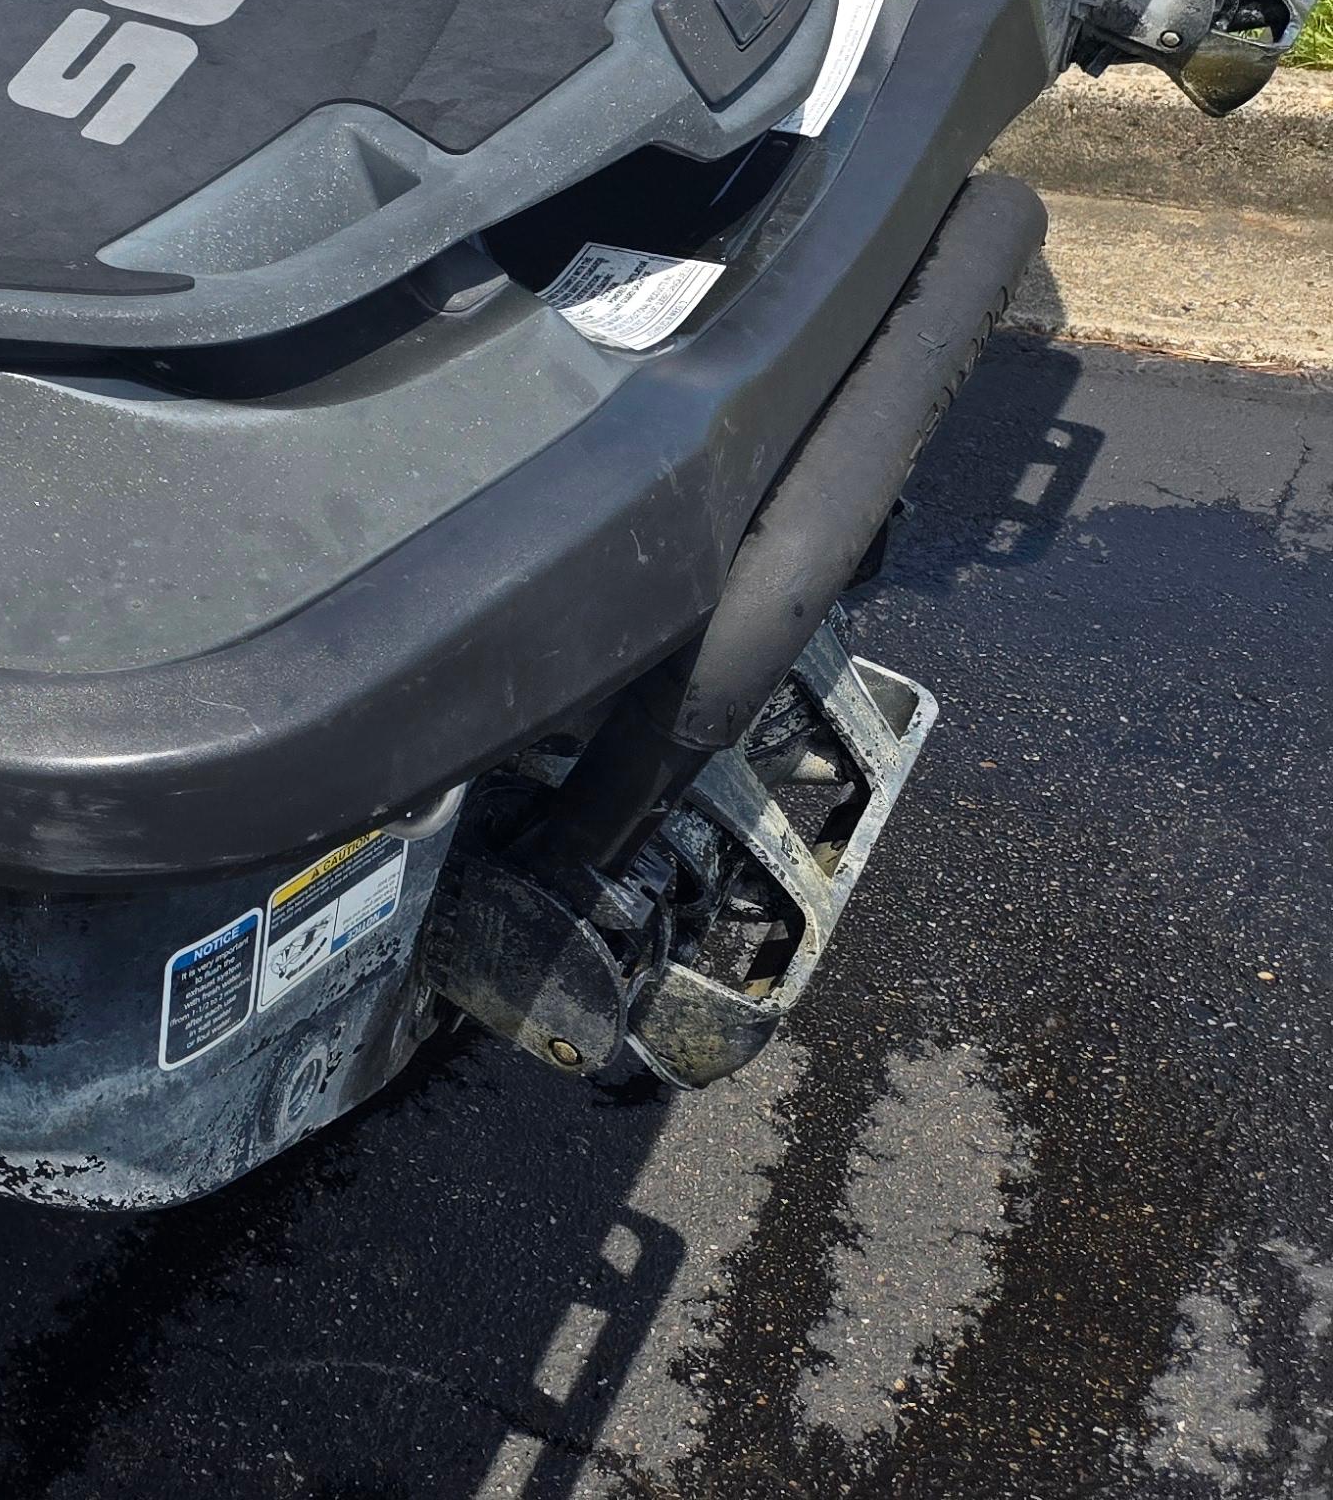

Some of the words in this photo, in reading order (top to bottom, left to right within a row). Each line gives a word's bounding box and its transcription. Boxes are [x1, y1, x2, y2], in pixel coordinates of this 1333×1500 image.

[322, 833, 370, 870] CAUTION
[193, 926, 240, 962] NOTICE
[197, 959, 214, 972] very
[215, 936, 250, 963] important
[185, 978, 215, 999] exhaust
[217, 961, 242, 982] system
[195, 976, 203, 984] to
[223, 956, 235, 967] the
[184, 997, 201, 1010] with
[202, 985, 221, 1000] fresh
[185, 1016, 203, 1030] after
[204, 1004, 223, 1019] each
[186, 1040, 195, 1049] or
[196, 1030, 210, 1044] foul
